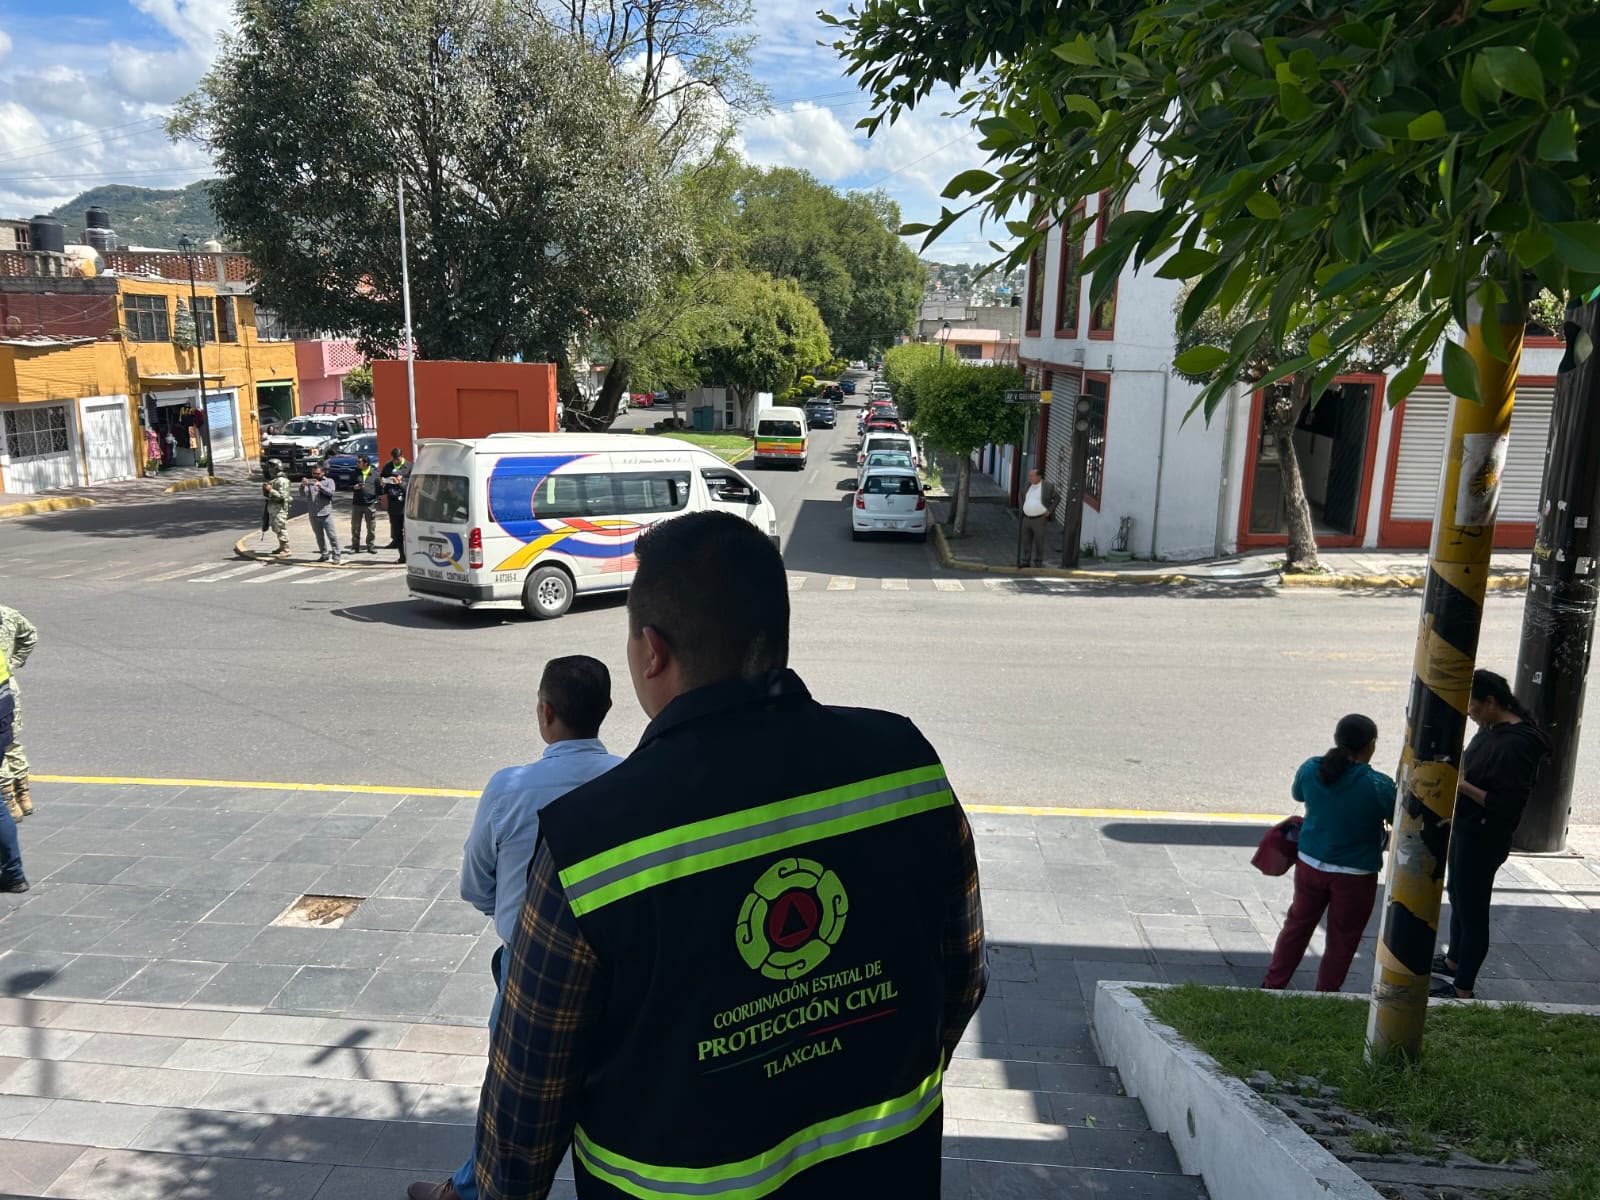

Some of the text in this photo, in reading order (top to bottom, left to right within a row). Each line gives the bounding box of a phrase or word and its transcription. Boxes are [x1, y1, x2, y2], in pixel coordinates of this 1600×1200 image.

[697, 980, 899, 1062] PROTECCIÓN CIVIL
[713, 960, 883, 1029] COORDINACIÓN ESTATAL DE
[763, 1036, 843, 1079] TLAXCALA
